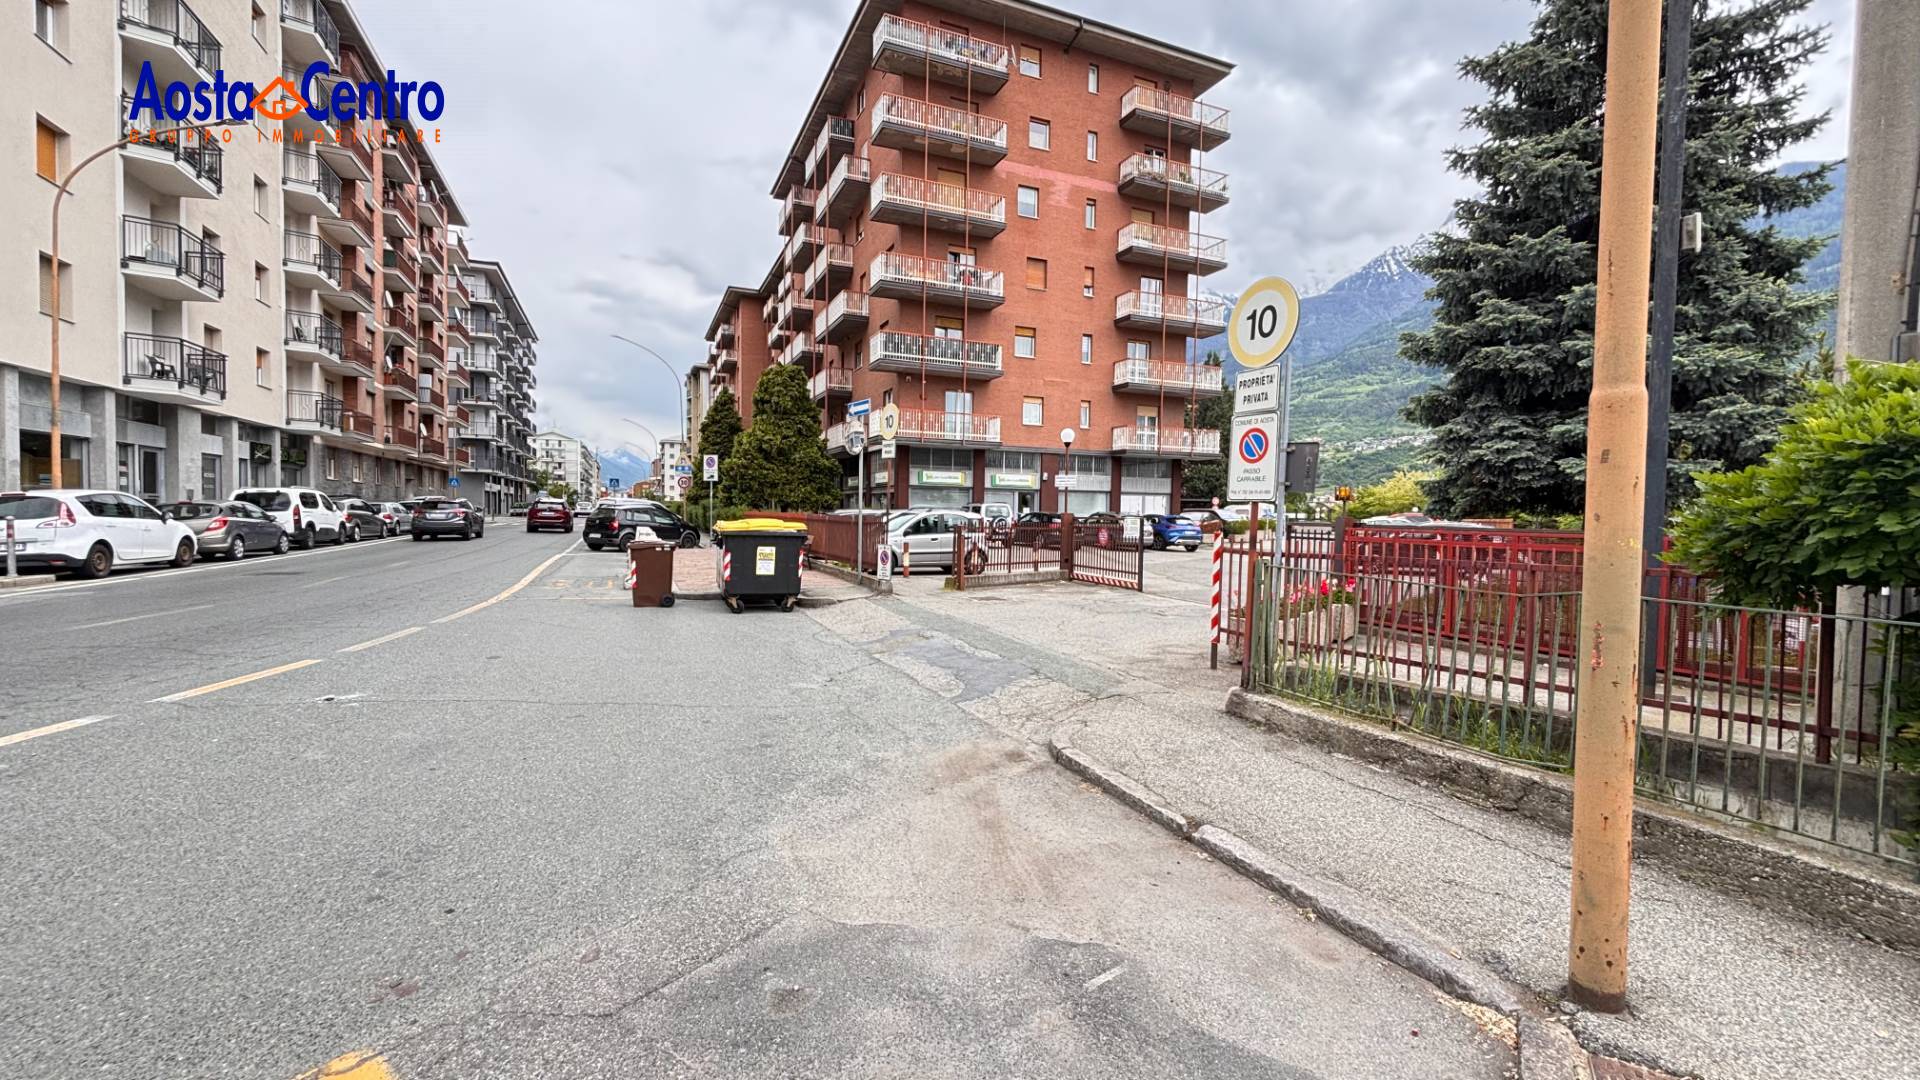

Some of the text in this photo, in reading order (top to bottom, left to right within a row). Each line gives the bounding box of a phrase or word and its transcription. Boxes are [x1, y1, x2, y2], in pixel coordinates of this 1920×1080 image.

[1246, 305, 1277, 341] 10
[1243, 392, 1269, 405] PRIVATA
[885, 415, 894, 429] 10
